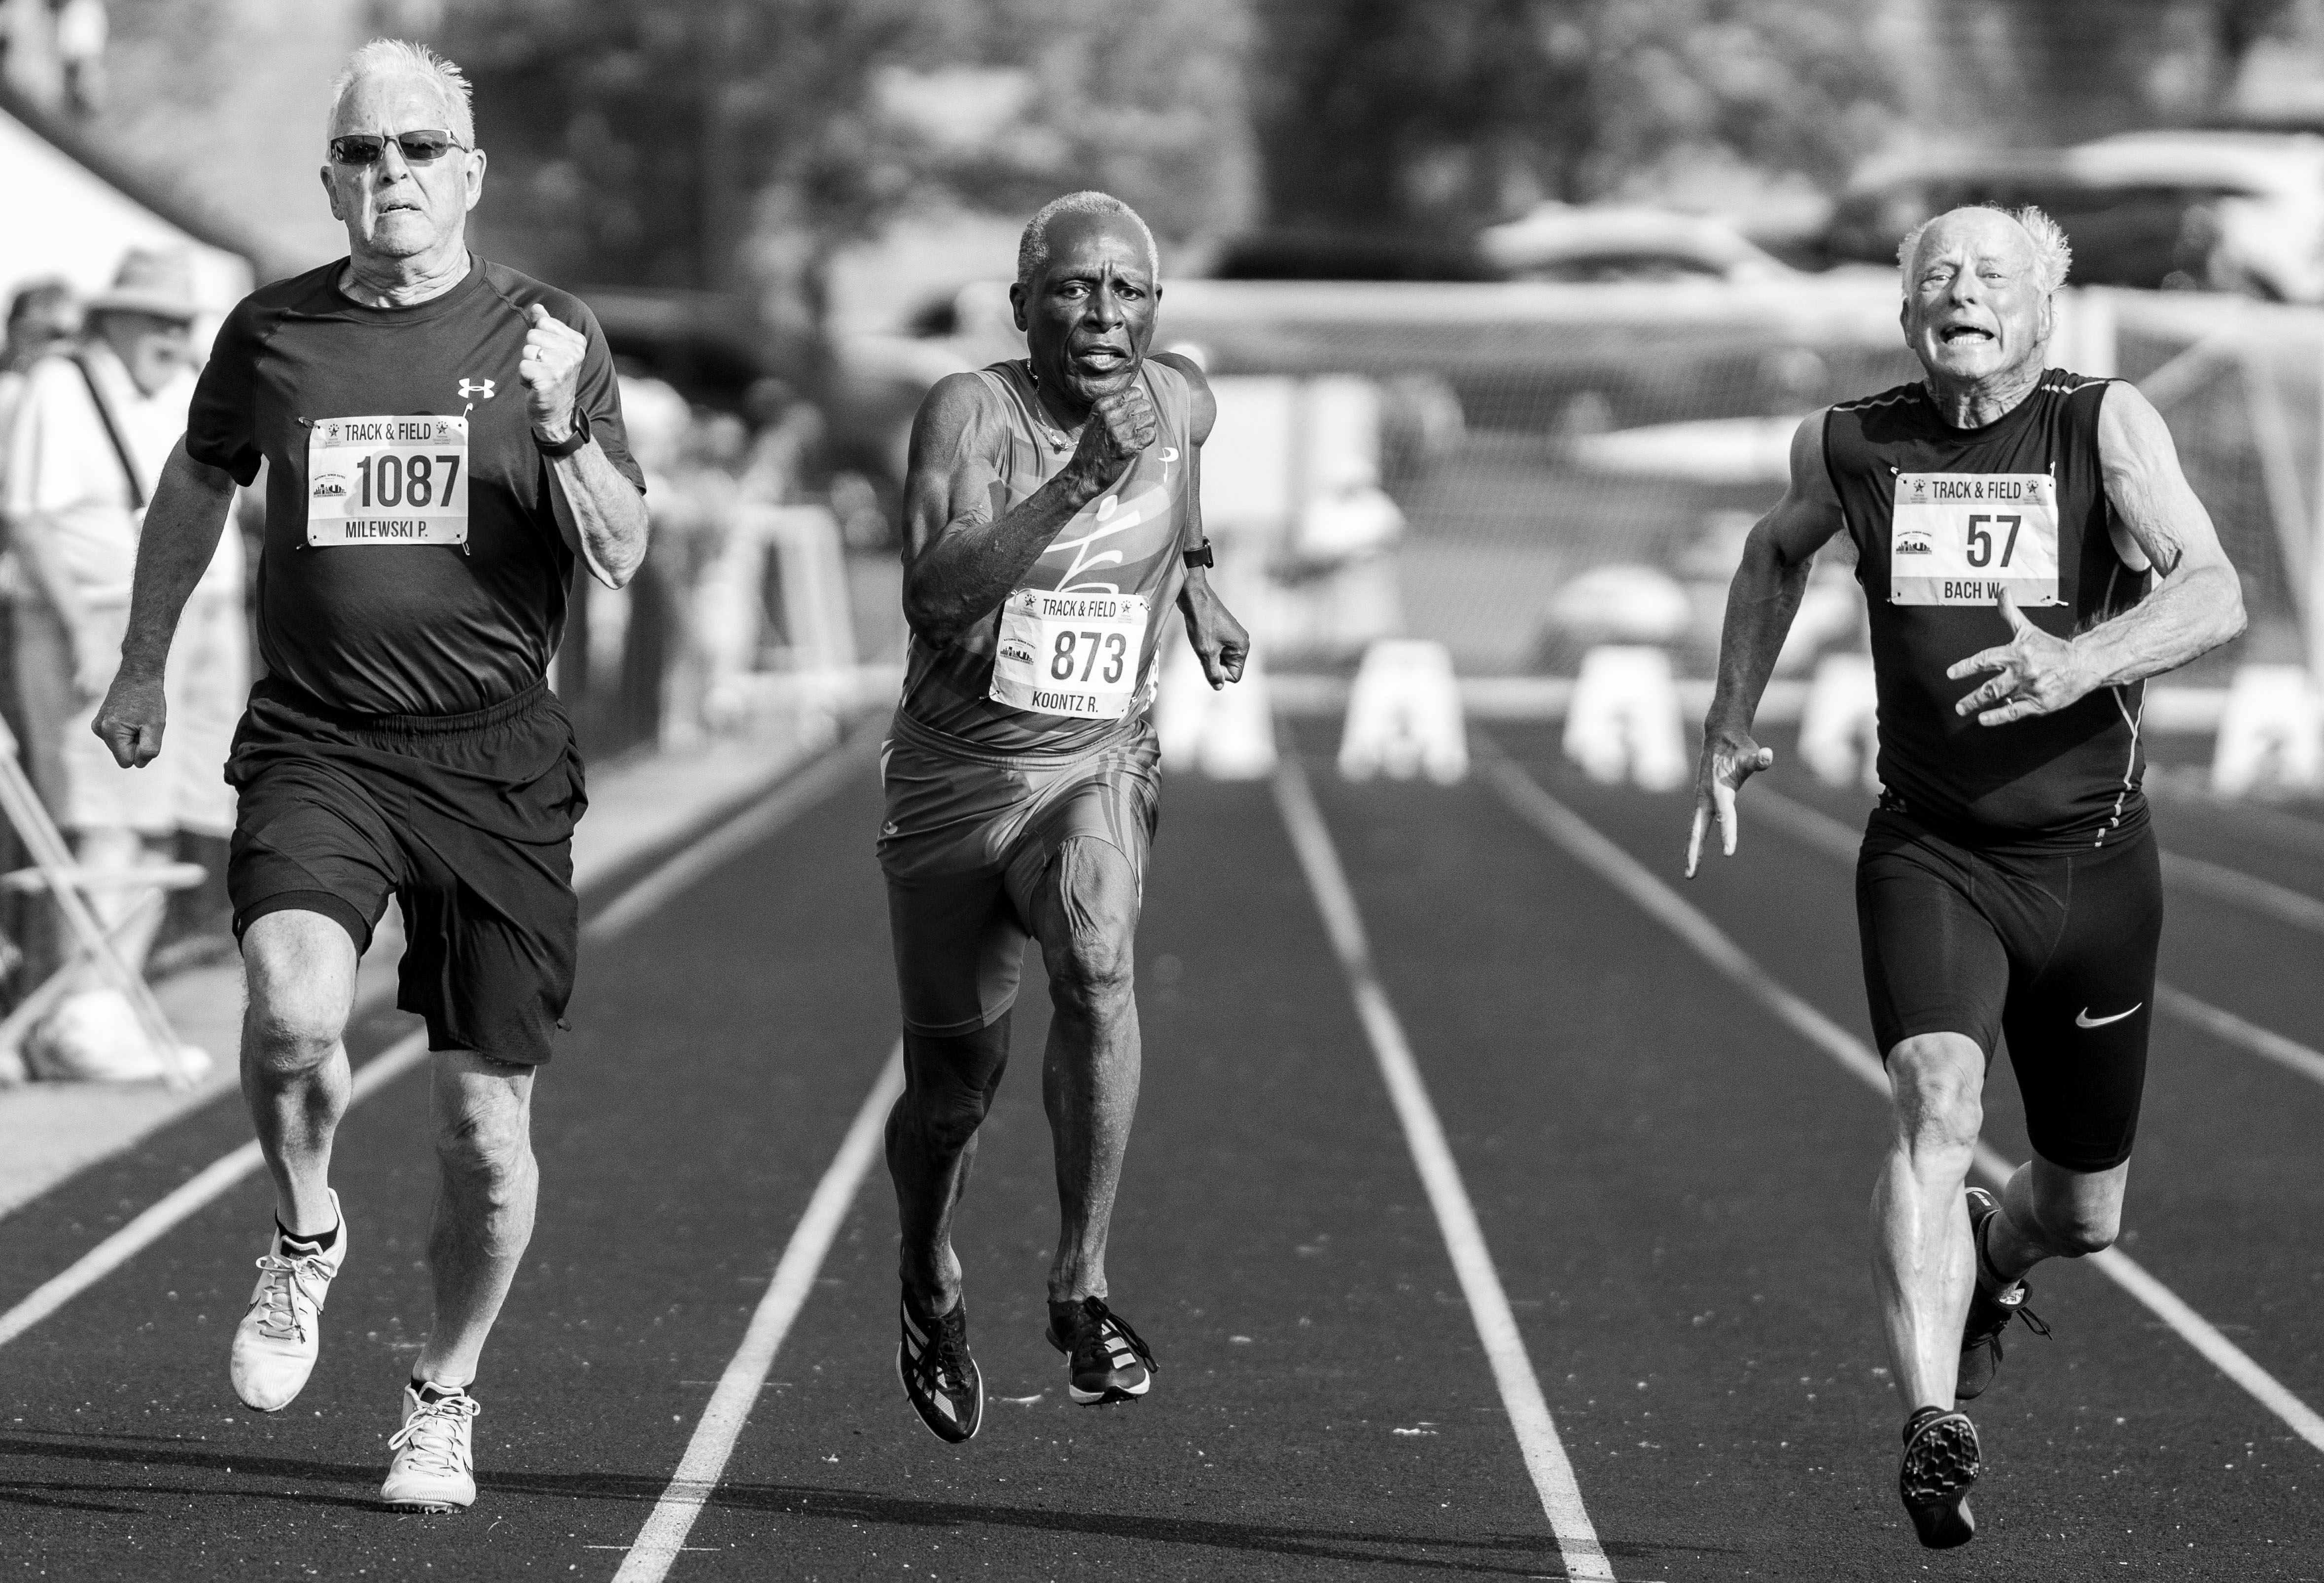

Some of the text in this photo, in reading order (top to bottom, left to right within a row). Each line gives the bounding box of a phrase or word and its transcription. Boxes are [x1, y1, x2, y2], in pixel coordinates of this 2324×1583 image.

[345, 424, 382, 441] TRACK
[386, 424, 395, 440] &
[399, 423, 431, 440] FIELD
[357, 455, 460, 507] 1087
[1932, 481, 1972, 499] TRACK
[1974, 481, 1983, 499] &
[1988, 481, 2021, 499] FIELD
[346, 521, 428, 538] MILEWSKI P.
[1967, 514, 2021, 568] 57
[1944, 581, 2000, 599] BACH W
[1043, 598, 1077, 616] TRACK
[1078, 601, 1086, 616] &
[1088, 601, 1116, 617] FIELD
[1051, 631, 1127, 684] 873
[1031, 690, 1098, 713] KOONTZ R.
